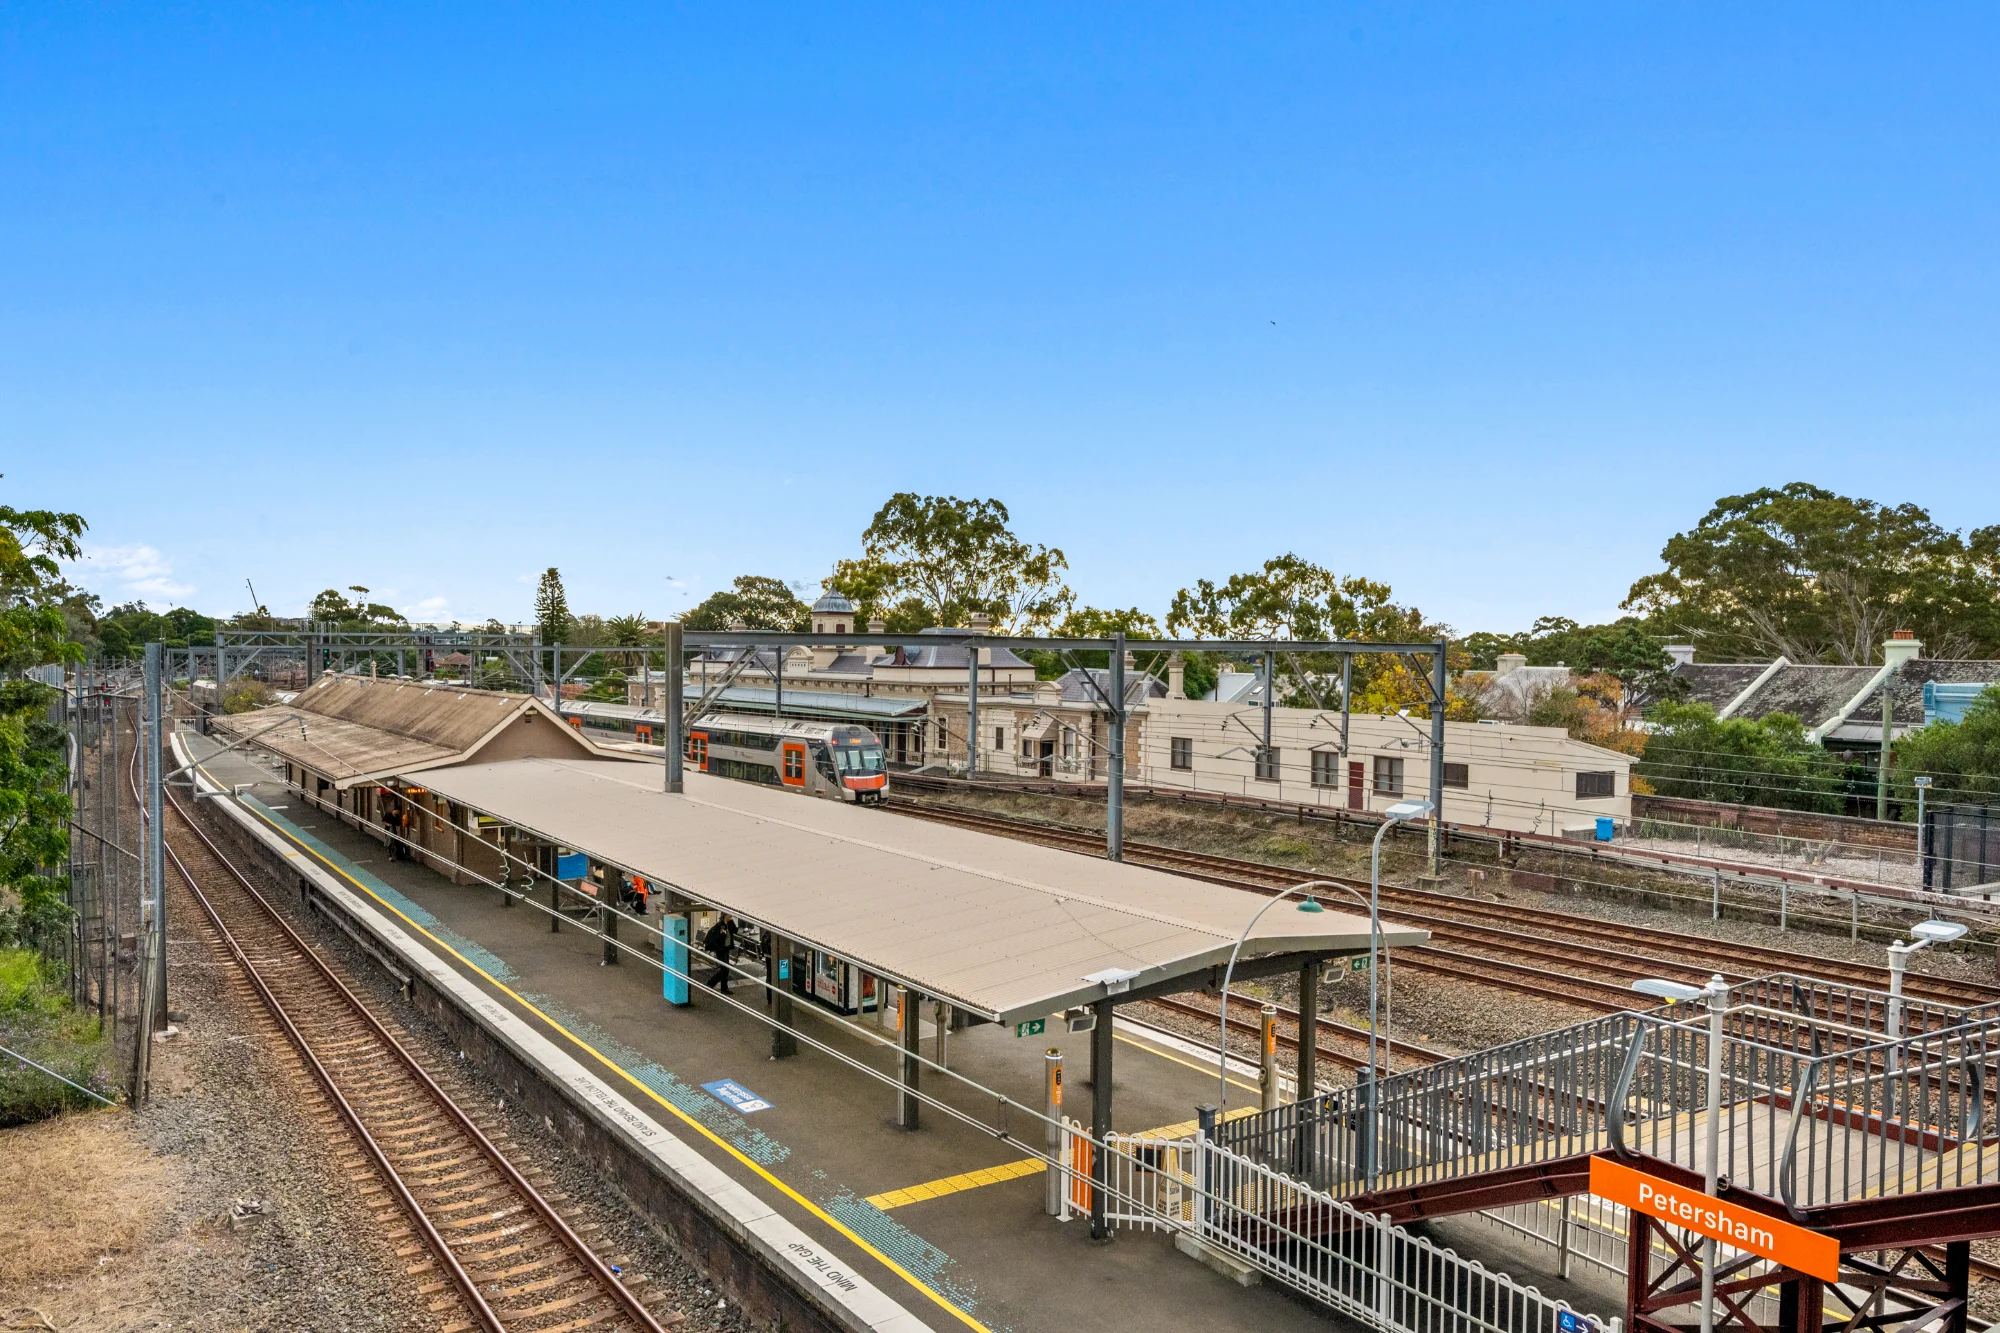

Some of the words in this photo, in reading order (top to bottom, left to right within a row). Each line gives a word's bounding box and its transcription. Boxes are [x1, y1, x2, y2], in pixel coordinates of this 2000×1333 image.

[631, 1121, 658, 1137] STAND
[1639, 1182, 1774, 1251] Petersham
[787, 1243, 814, 1258] GAP
[806, 1256, 832, 1273] THE
[826, 1271, 858, 1292] MIND
